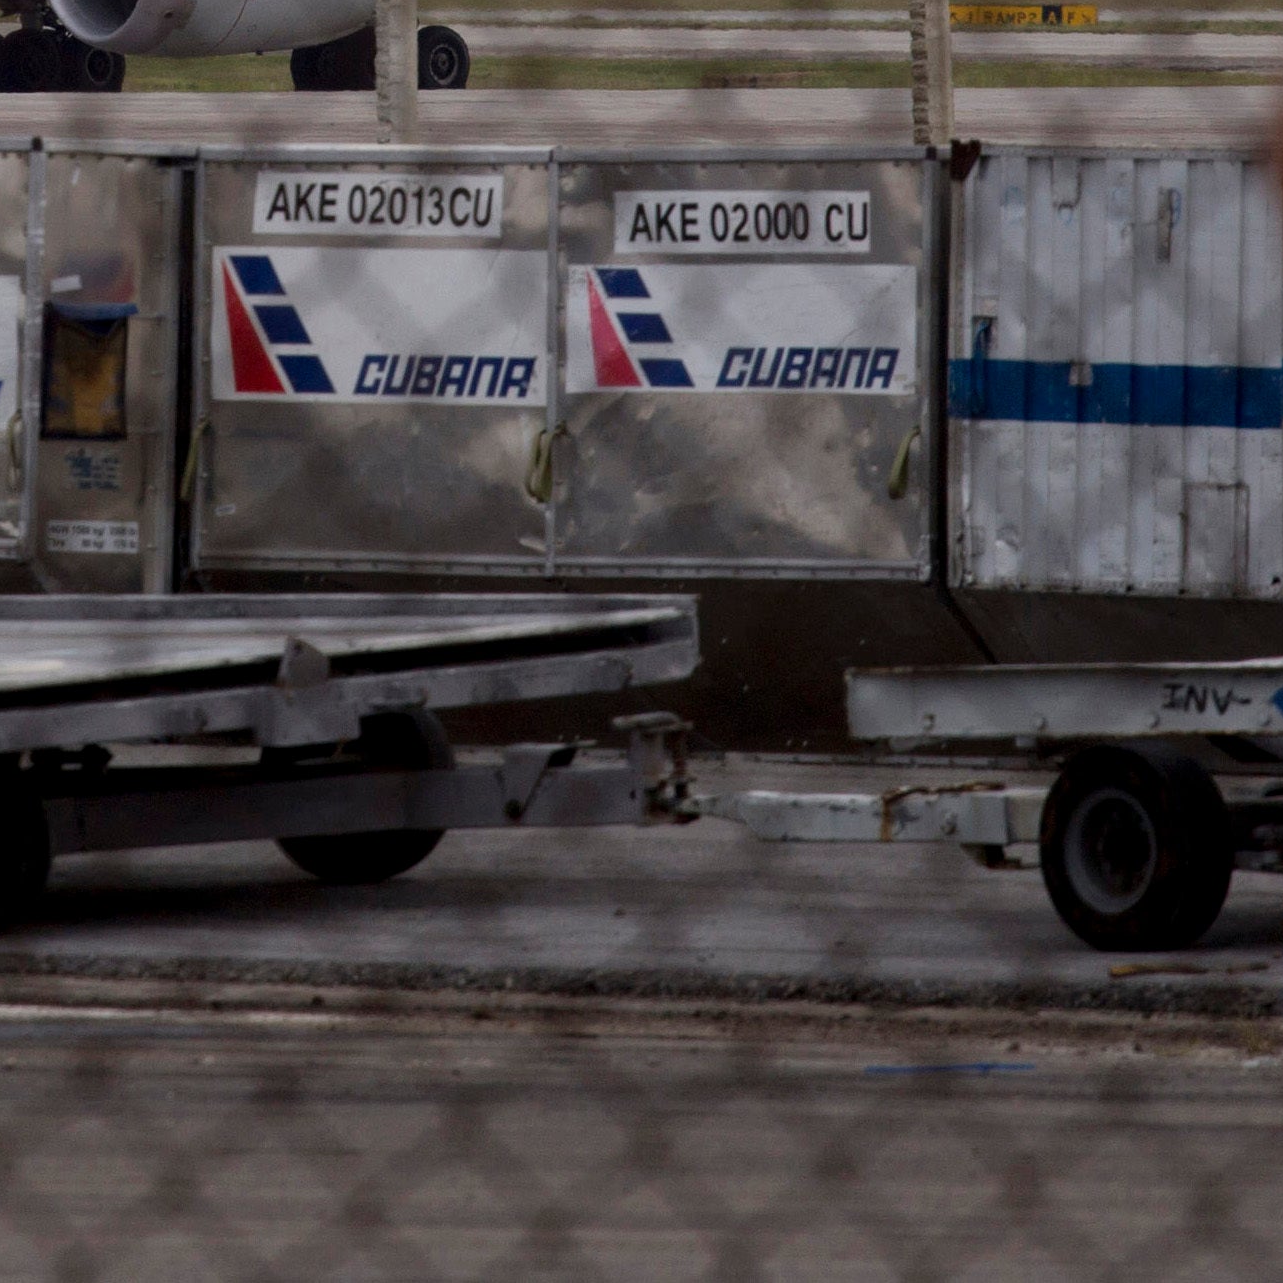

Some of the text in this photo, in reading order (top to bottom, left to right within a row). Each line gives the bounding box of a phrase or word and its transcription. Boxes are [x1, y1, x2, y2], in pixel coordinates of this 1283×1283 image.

[267, 182, 340, 223] AKE
[629, 202, 868, 243] AKE 02000 CU
[353, 354, 537, 398] CUBANA
[716, 347, 900, 388] CUBANA
